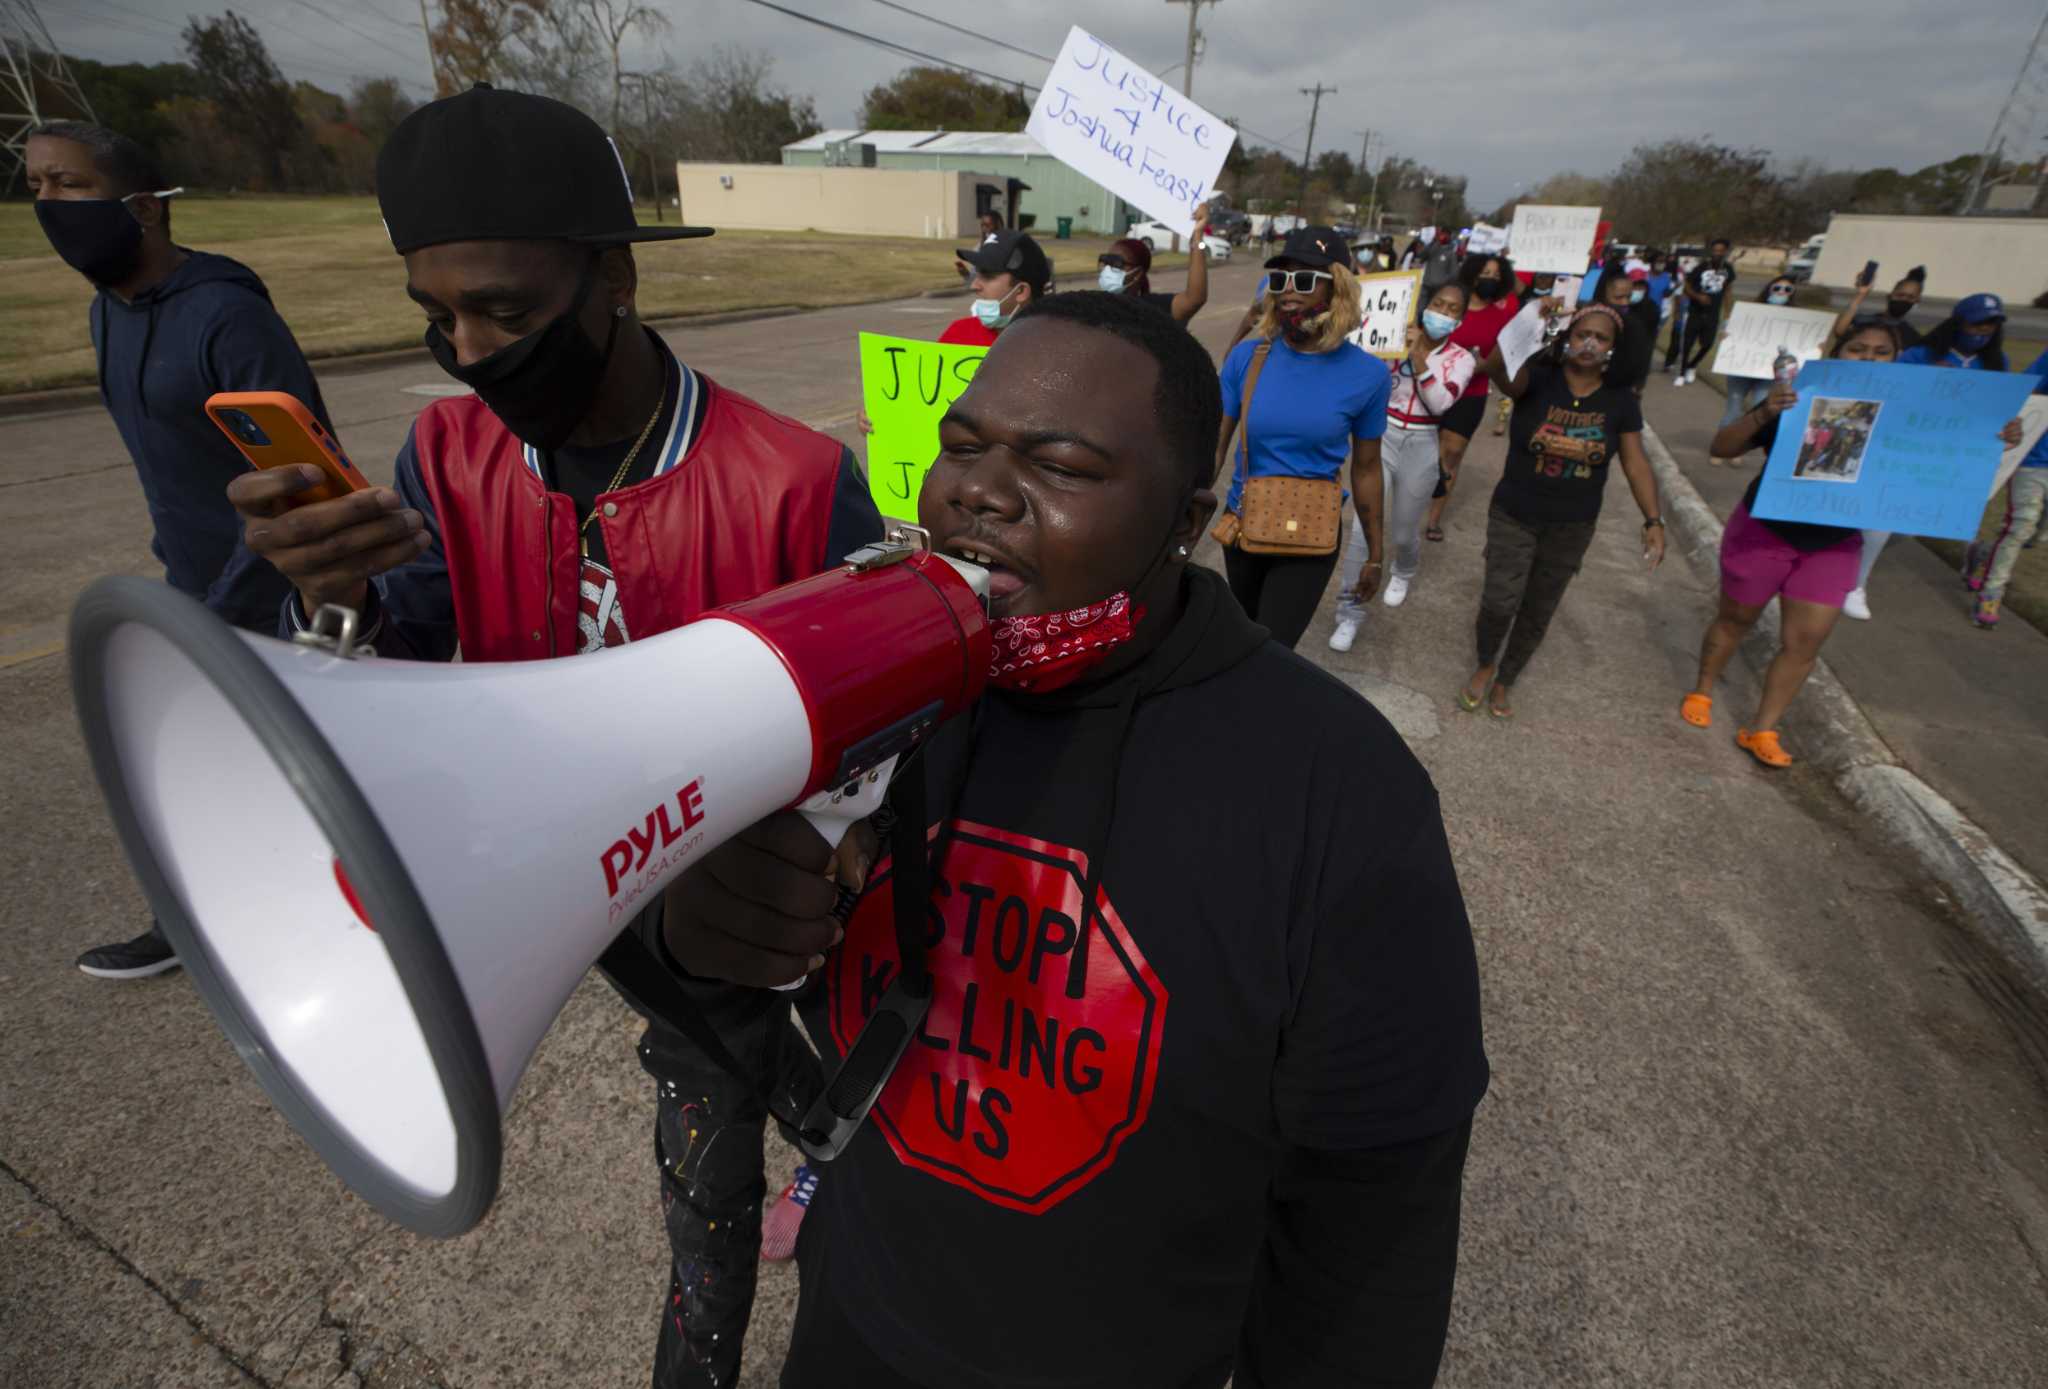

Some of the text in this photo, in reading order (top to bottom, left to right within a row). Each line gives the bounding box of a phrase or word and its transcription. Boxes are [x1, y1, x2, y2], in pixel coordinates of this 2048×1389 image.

[1047, 86, 1206, 211] Joshua Feast
[1073, 35, 1210, 150] Justice
[1113, 106, 1142, 136] 4
[1366, 297, 1373, 311] A
[600, 780, 705, 898] PYLE
[862, 953, 1107, 1096] KLLING
[931, 1072, 1012, 1161] US
